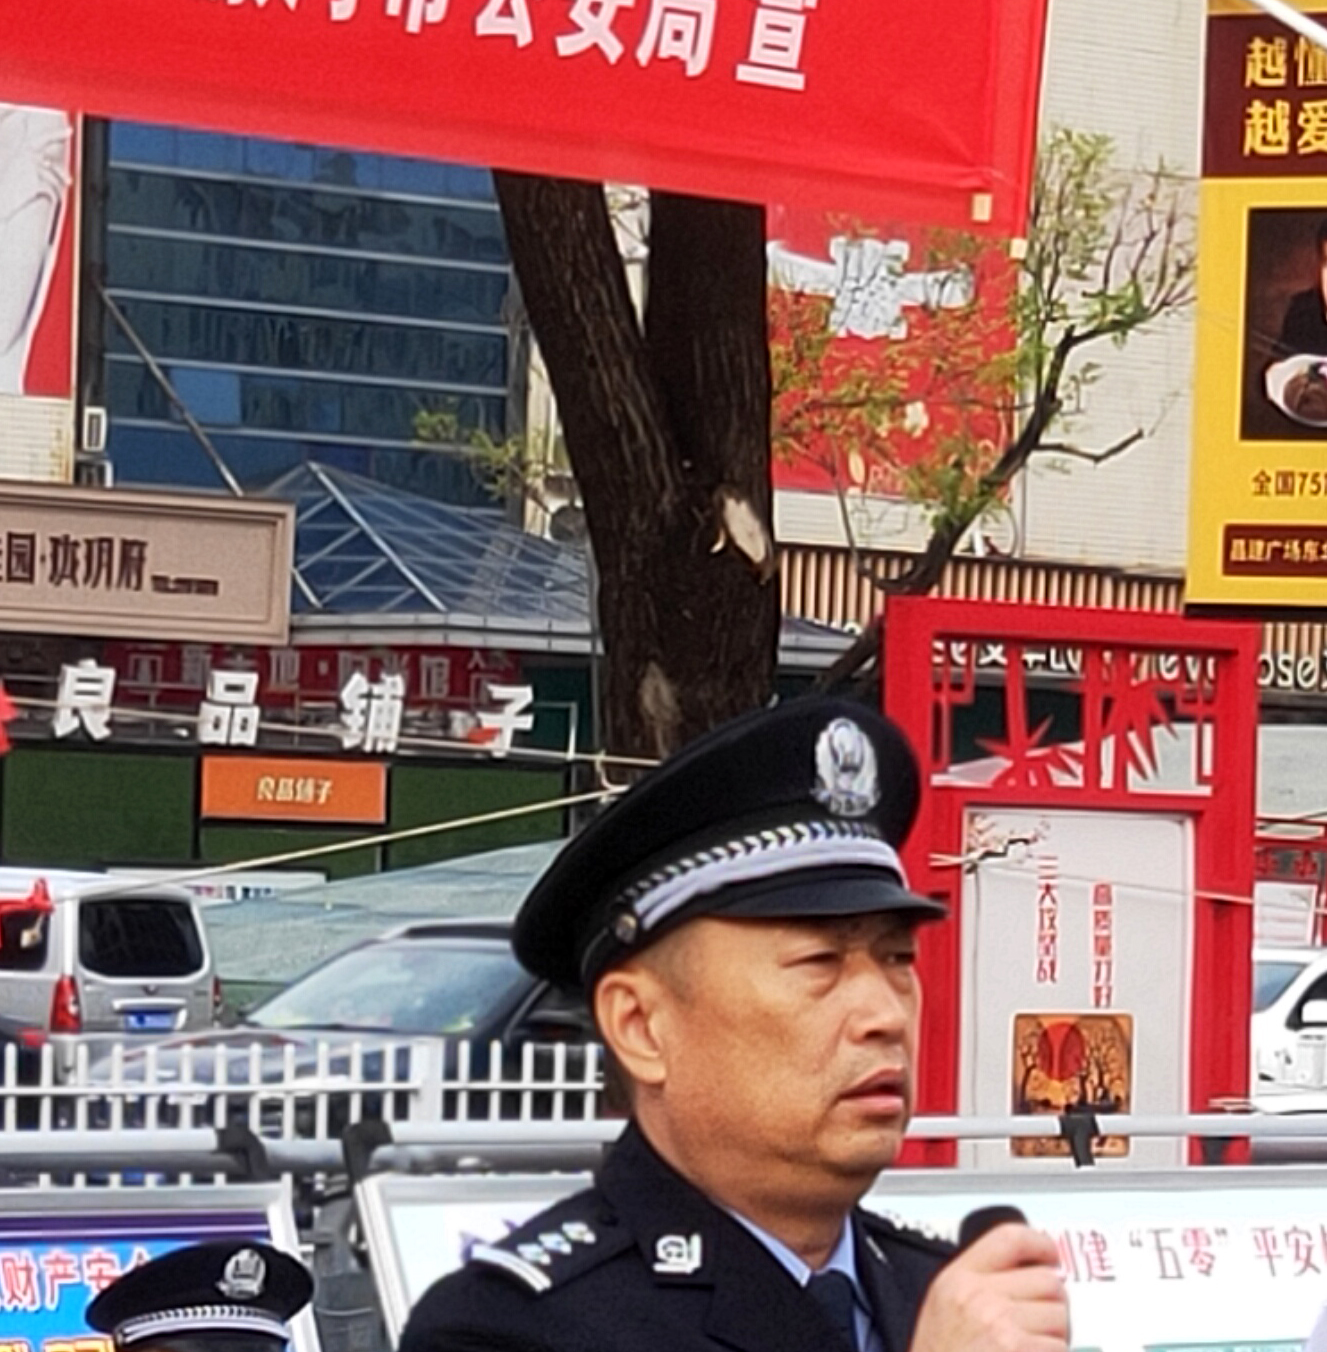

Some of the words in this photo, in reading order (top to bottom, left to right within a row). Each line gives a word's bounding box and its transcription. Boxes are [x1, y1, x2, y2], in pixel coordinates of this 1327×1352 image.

[52, 658, 534, 757] 良品铺子
[256, 776, 333, 804] 良品铺子
